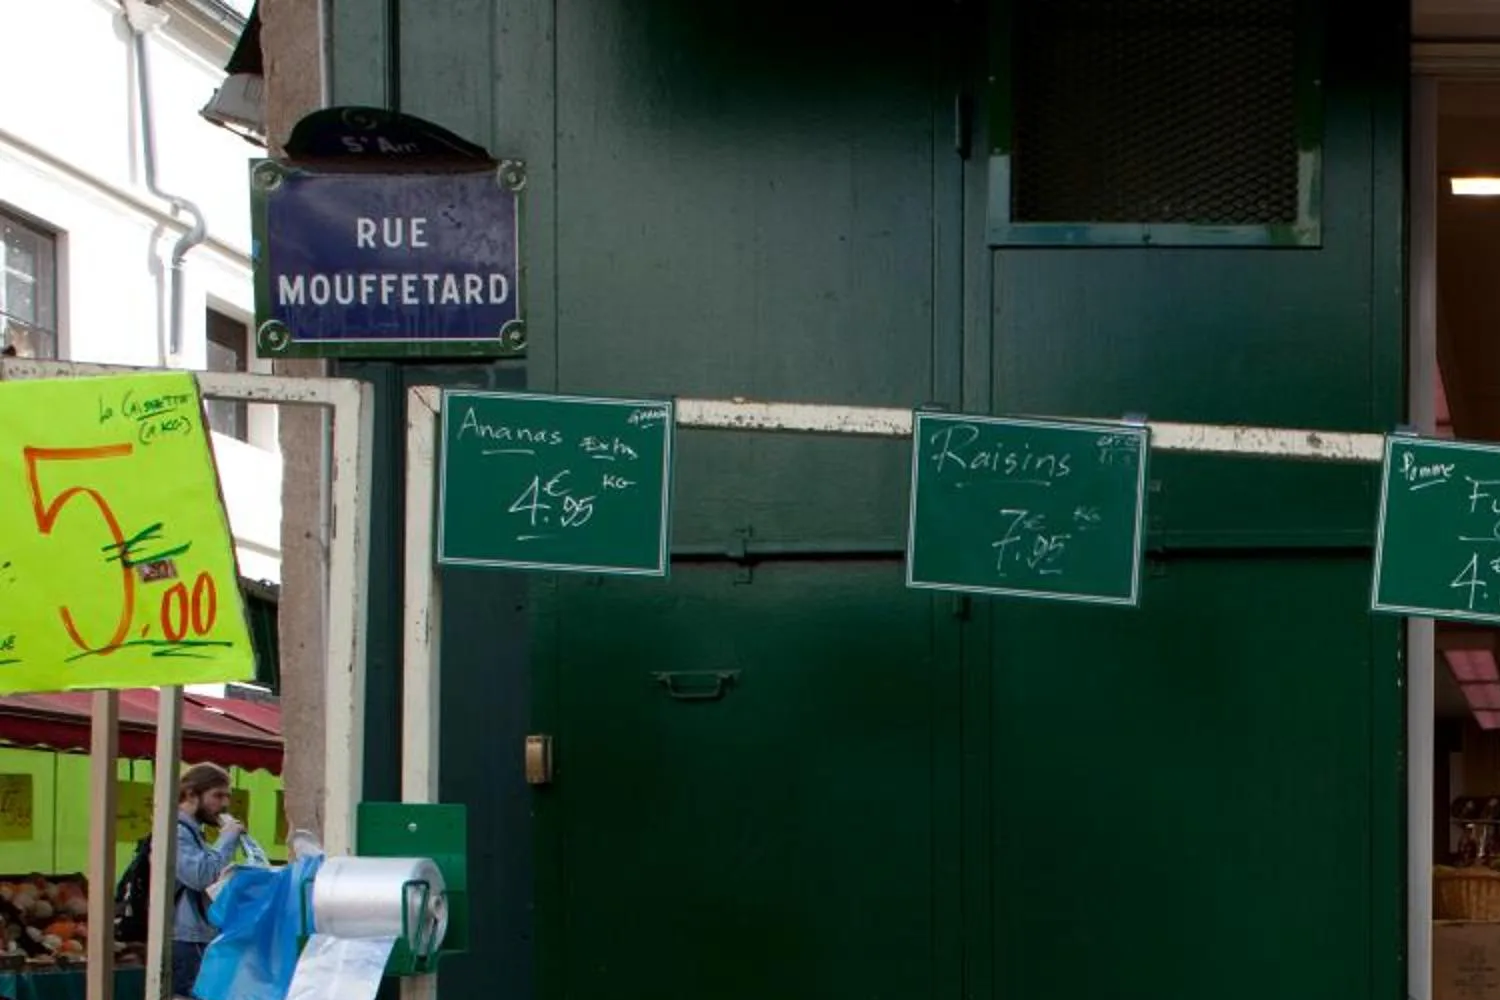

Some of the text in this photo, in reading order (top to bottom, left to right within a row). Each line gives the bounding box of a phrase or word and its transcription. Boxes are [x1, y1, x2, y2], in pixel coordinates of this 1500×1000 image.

[357, 218, 428, 247] RUE
[278, 274, 508, 305] MOUFFETARD
[457, 407, 563, 445] Ananas
[930, 424, 1071, 477] Raisins
